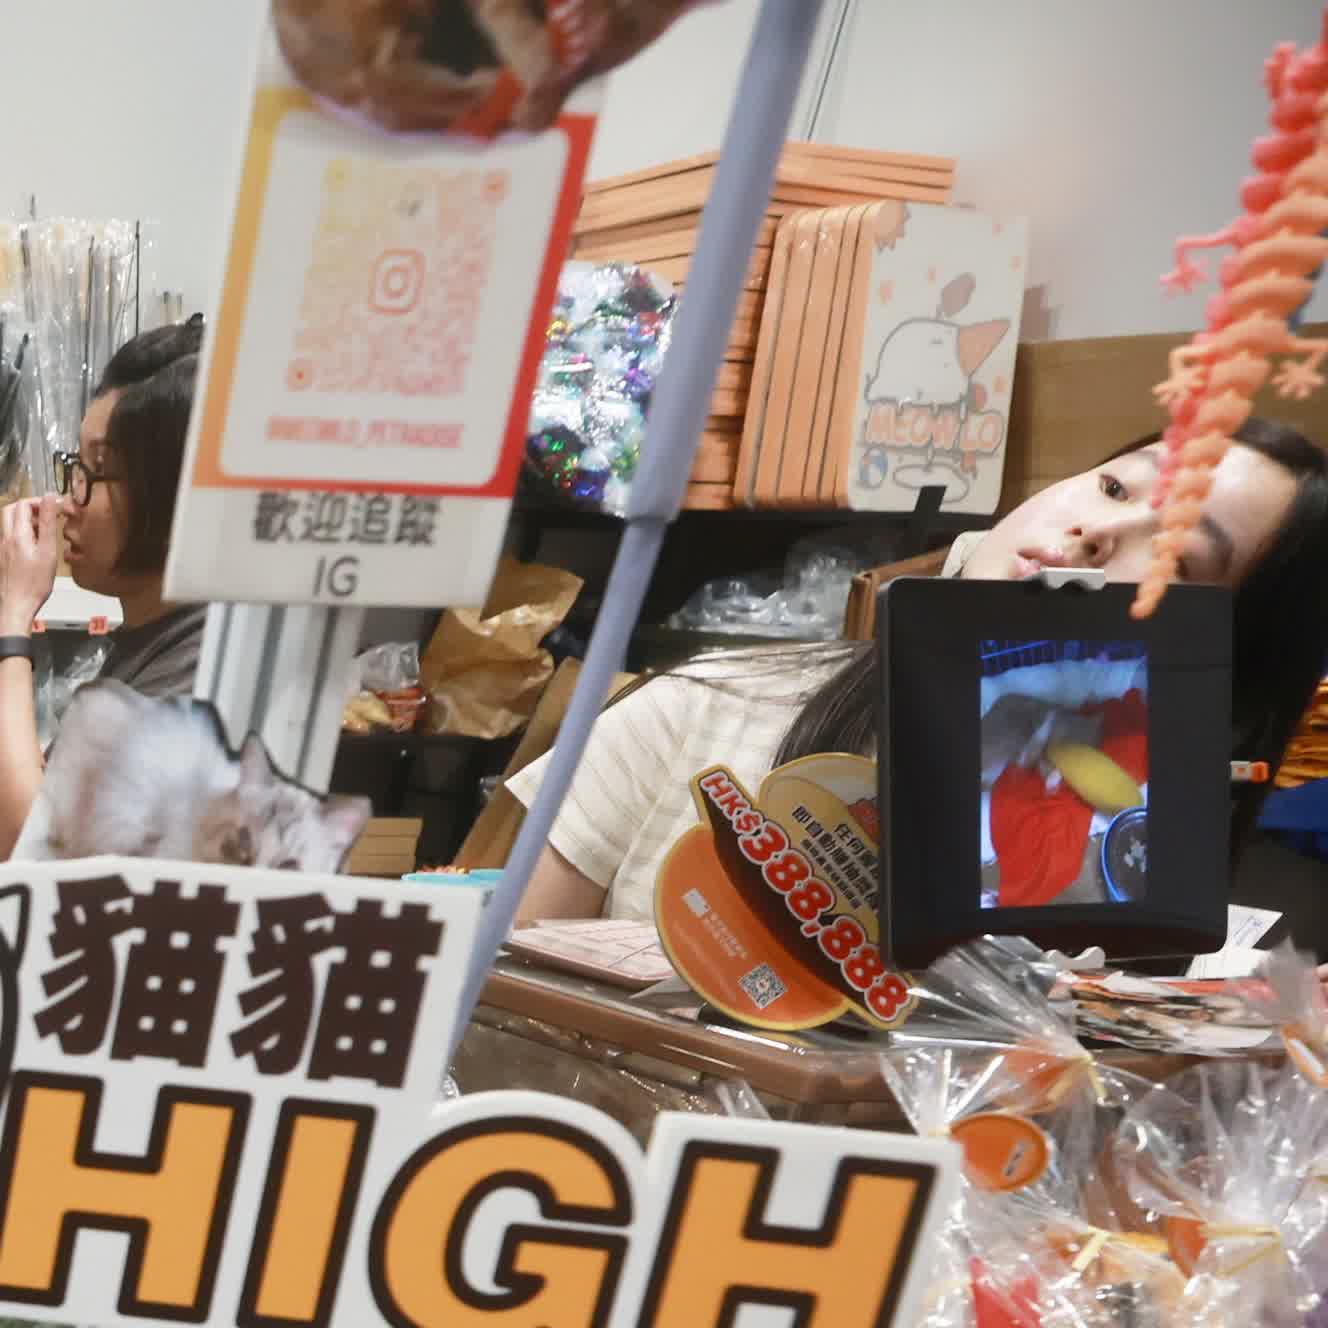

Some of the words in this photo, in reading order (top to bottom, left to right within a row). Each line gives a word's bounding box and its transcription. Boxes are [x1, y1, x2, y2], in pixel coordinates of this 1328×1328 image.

[312, 555, 360, 598] IG
[34, 874, 444, 1087] 貓貓
[700, 772, 911, 1020] HK$388,888
